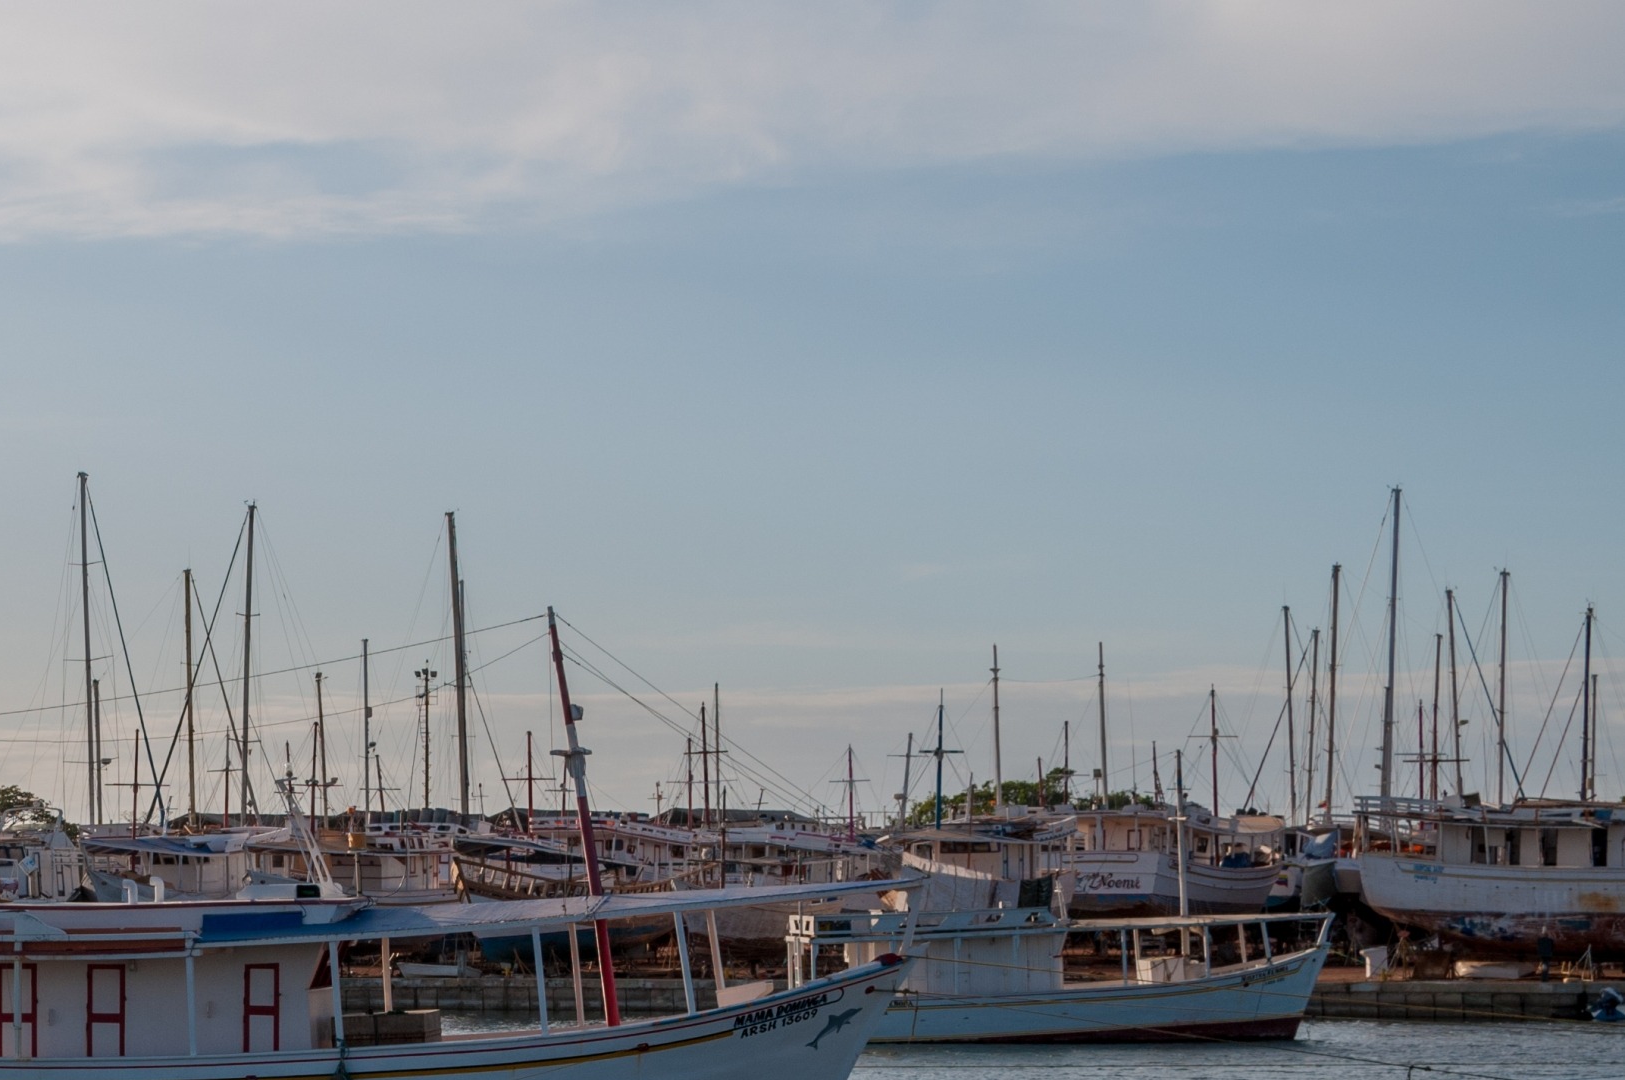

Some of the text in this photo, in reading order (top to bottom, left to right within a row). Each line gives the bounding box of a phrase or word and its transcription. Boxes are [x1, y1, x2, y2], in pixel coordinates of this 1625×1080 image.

[733, 994, 828, 1028] MAMA DOMINGA
[740, 1008, 818, 1039] ARSH 13609
